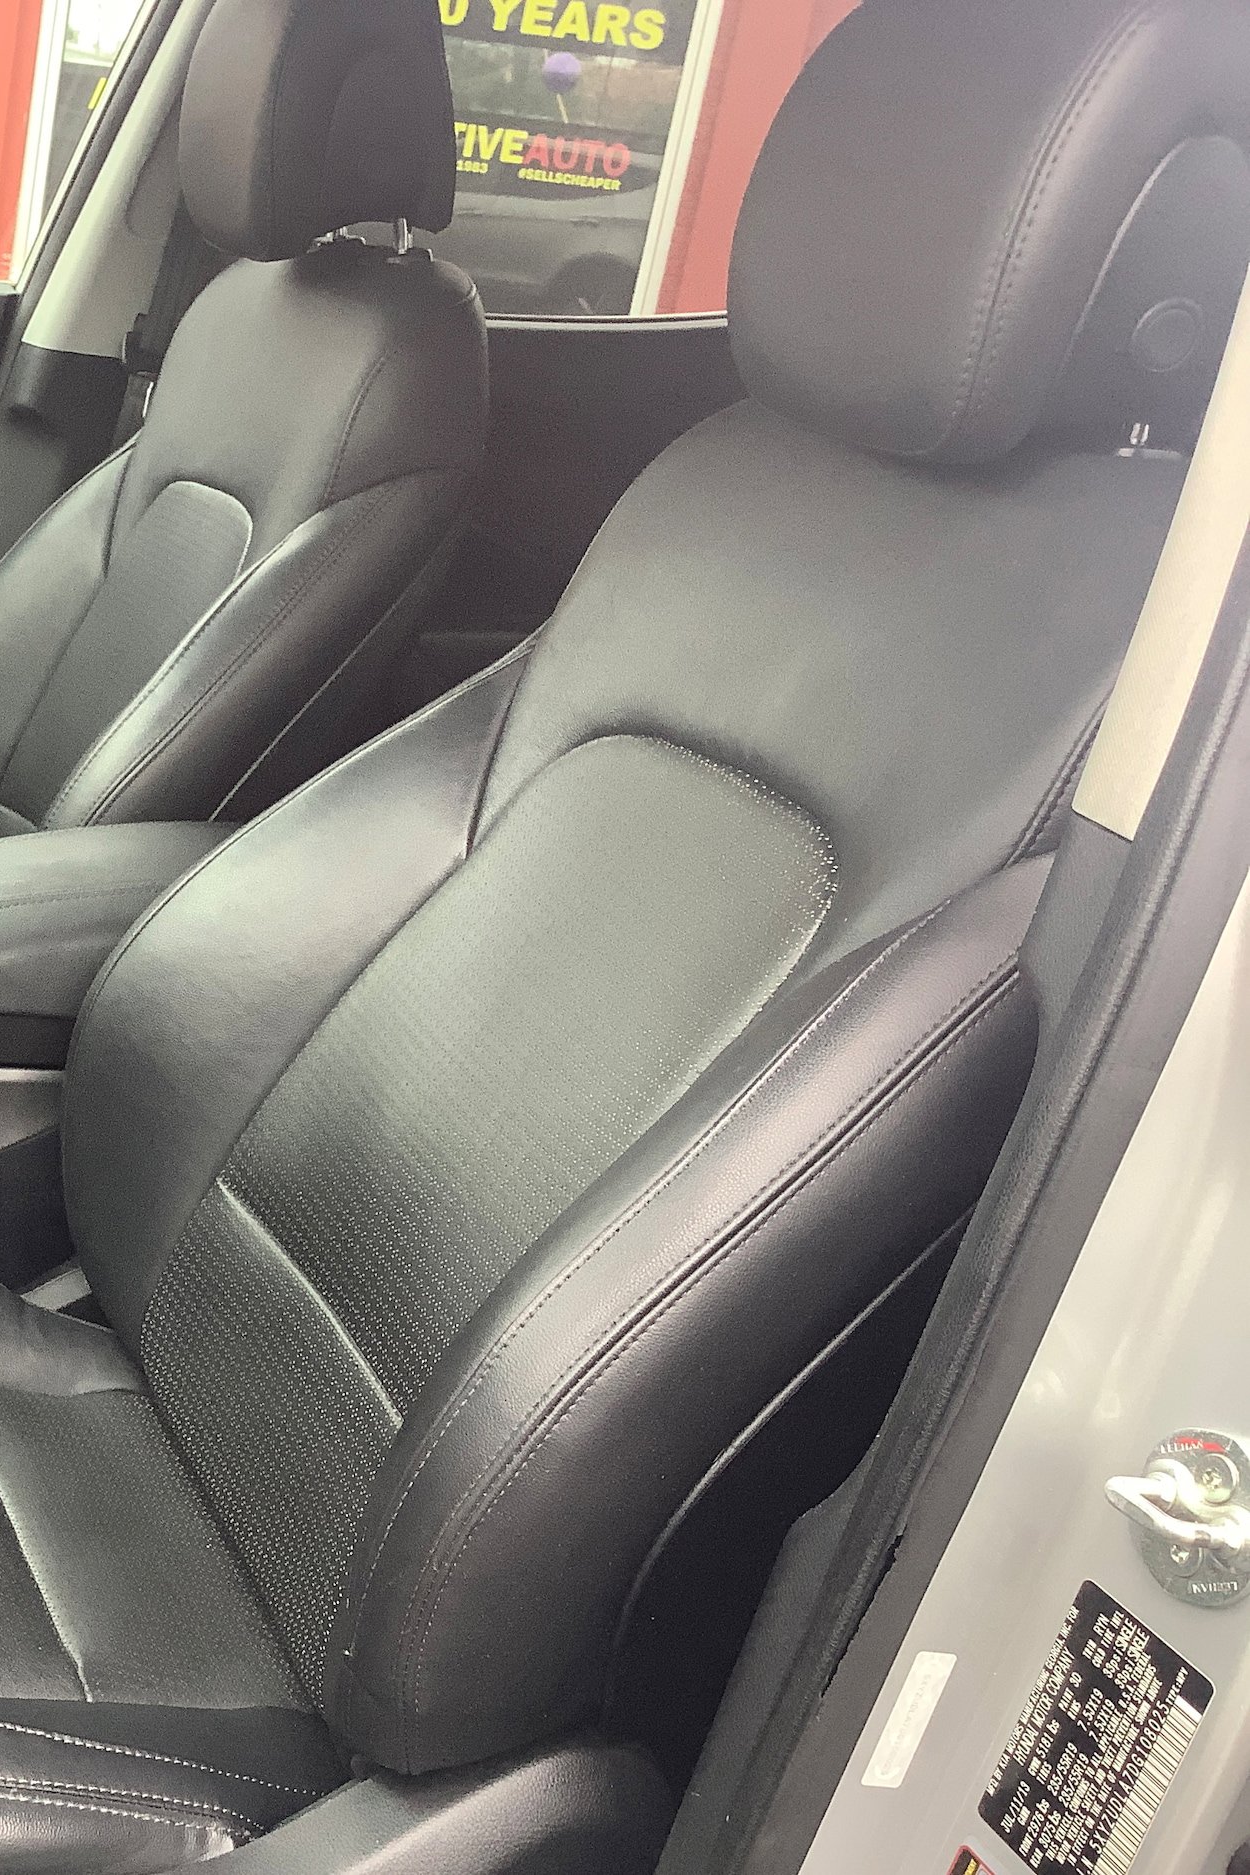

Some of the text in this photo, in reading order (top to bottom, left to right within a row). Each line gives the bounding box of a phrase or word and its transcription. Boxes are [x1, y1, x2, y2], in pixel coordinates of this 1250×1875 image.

[486, 0, 667, 50] YEARS
[454, 121, 632, 178] TIVEAUTO
[993, 1766, 1003, 1780] BY
[998, 1753, 1010, 1769] KIA
[1005, 1723, 1023, 1754] MOTORS
[1019, 1668, 1049, 1724] MANUFACTURING
[1066, 1605, 1079, 1623] FOR
[1000, 1781, 1029, 1832] JUL/11/13
[1035, 1732, 1053, 1758] 5181
[1058, 1687, 1073, 1711] PAINT
[1082, 1639, 1096, 1659] TRIM
[1093, 1613, 1109, 1636] RYN
[1013, 1646, 1074, 1765] HYUNDAI MOTOR COMPANY
[1027, 1810, 1044, 1837] 2976
[1047, 1742, 1077, 1795] 235/55R19
[1077, 1688, 1102, 1730] 7.5JX19
[1036, 1761, 1051, 1784] TIRES
[1067, 1699, 1081, 1720] RIMS
[1091, 1647, 1105, 1667] COLD
[1100, 1628, 1114, 1647] TIRE
[1109, 1610, 1124, 1628] INFL
[1045, 1841, 1059, 1860] THIS
[1054, 1811, 1073, 1842] VEHICLE
[1069, 1777, 1089, 1812] CONFORMS
[1084, 1766, 1095, 1778] TO
[1090, 1752, 1102, 1768] ALL
[1098, 1708, 1122, 1752] APPLICABLE
[1130, 1650, 1150, 1682] FEDERAL
[1055, 1663, 1156, 1864] MOTOR VEHICLE SAFETY AND THEFT PREVENTION STANDARDS
[1067, 1676, 1162, 1866] IN EFFECT ON THE DATE OF MANUFACTURE SHOWN ABOVE
[1089, 1701, 1168, 1853] 5XYZUDLA7DG108025
[1029, 1847, 1043, 1867] REAR
[1038, 1821, 1055, 1848] 3075
[1058, 1753, 1088, 1807] 235/55R19
[1088, 1699, 1114, 1741] 7.5JX19
